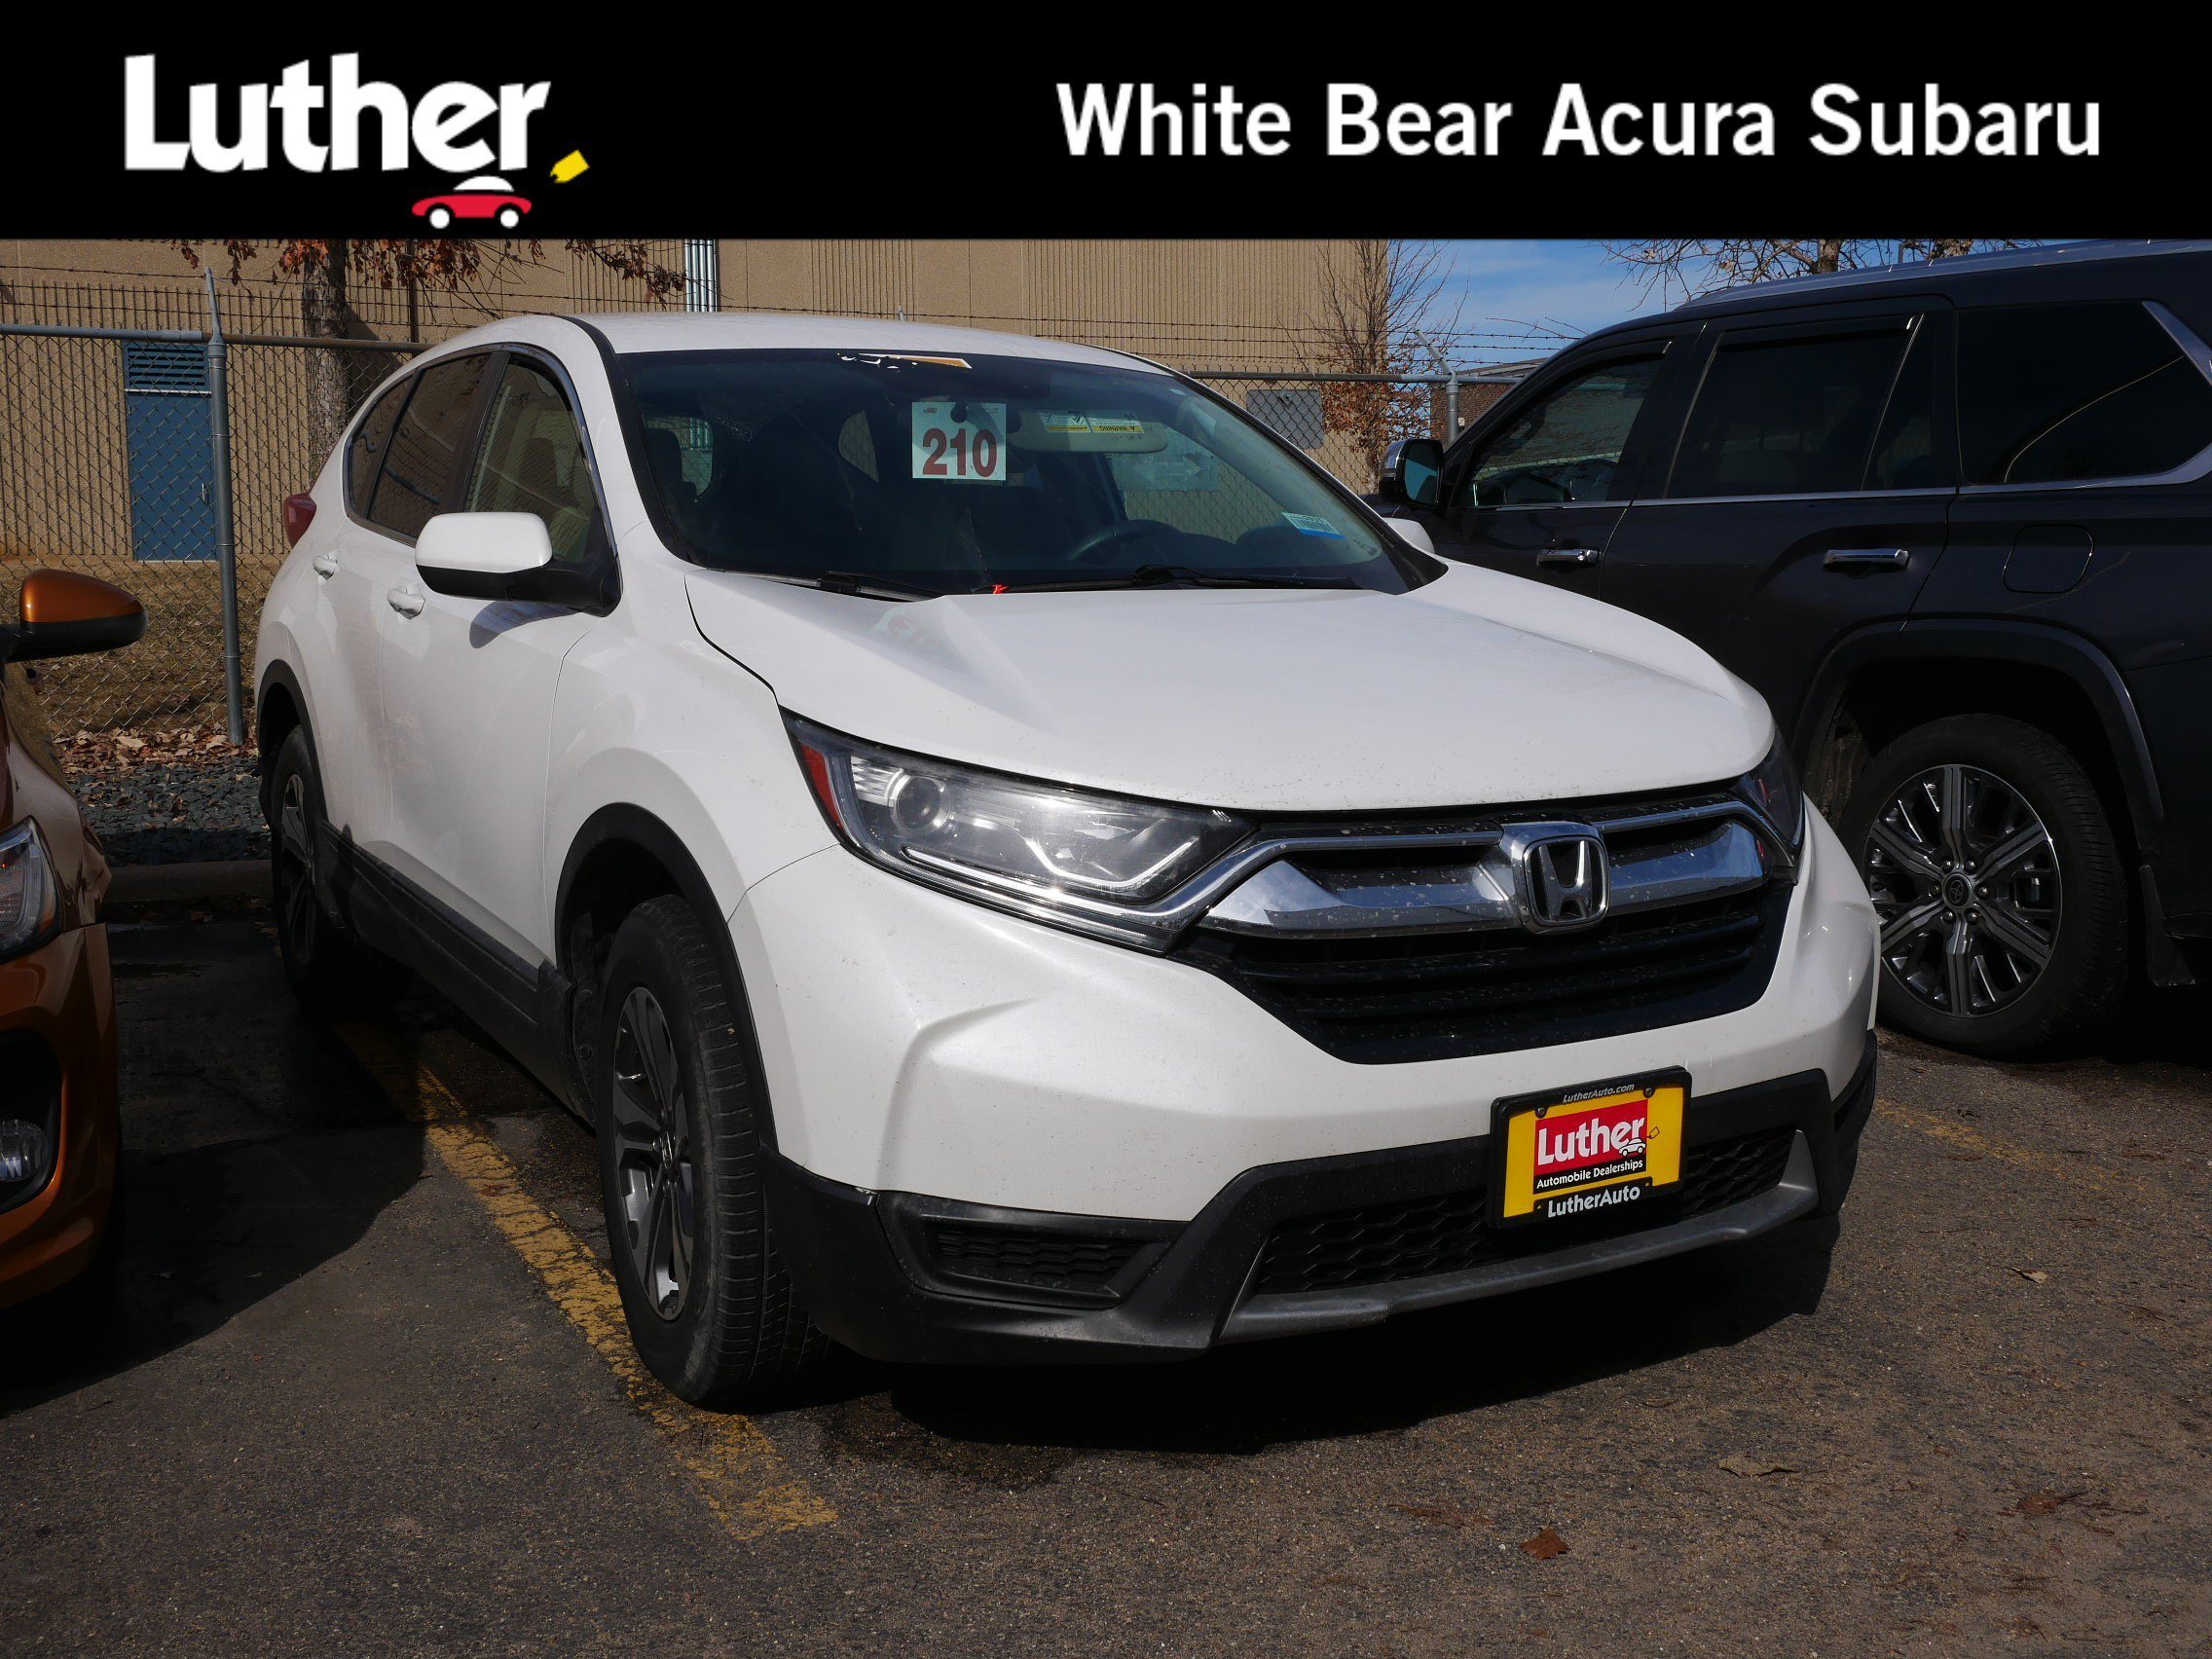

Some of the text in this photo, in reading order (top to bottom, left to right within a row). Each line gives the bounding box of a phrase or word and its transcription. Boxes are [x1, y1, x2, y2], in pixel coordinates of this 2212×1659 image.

[922, 427, 997, 477] 210
[1563, 1084, 1635, 1103] LutherAuto.com
[1537, 1117, 1645, 1166] Luther
[1536, 1159, 1643, 1189] Automobile Dealerships
[1547, 1185, 1641, 1218] LutherAuto
